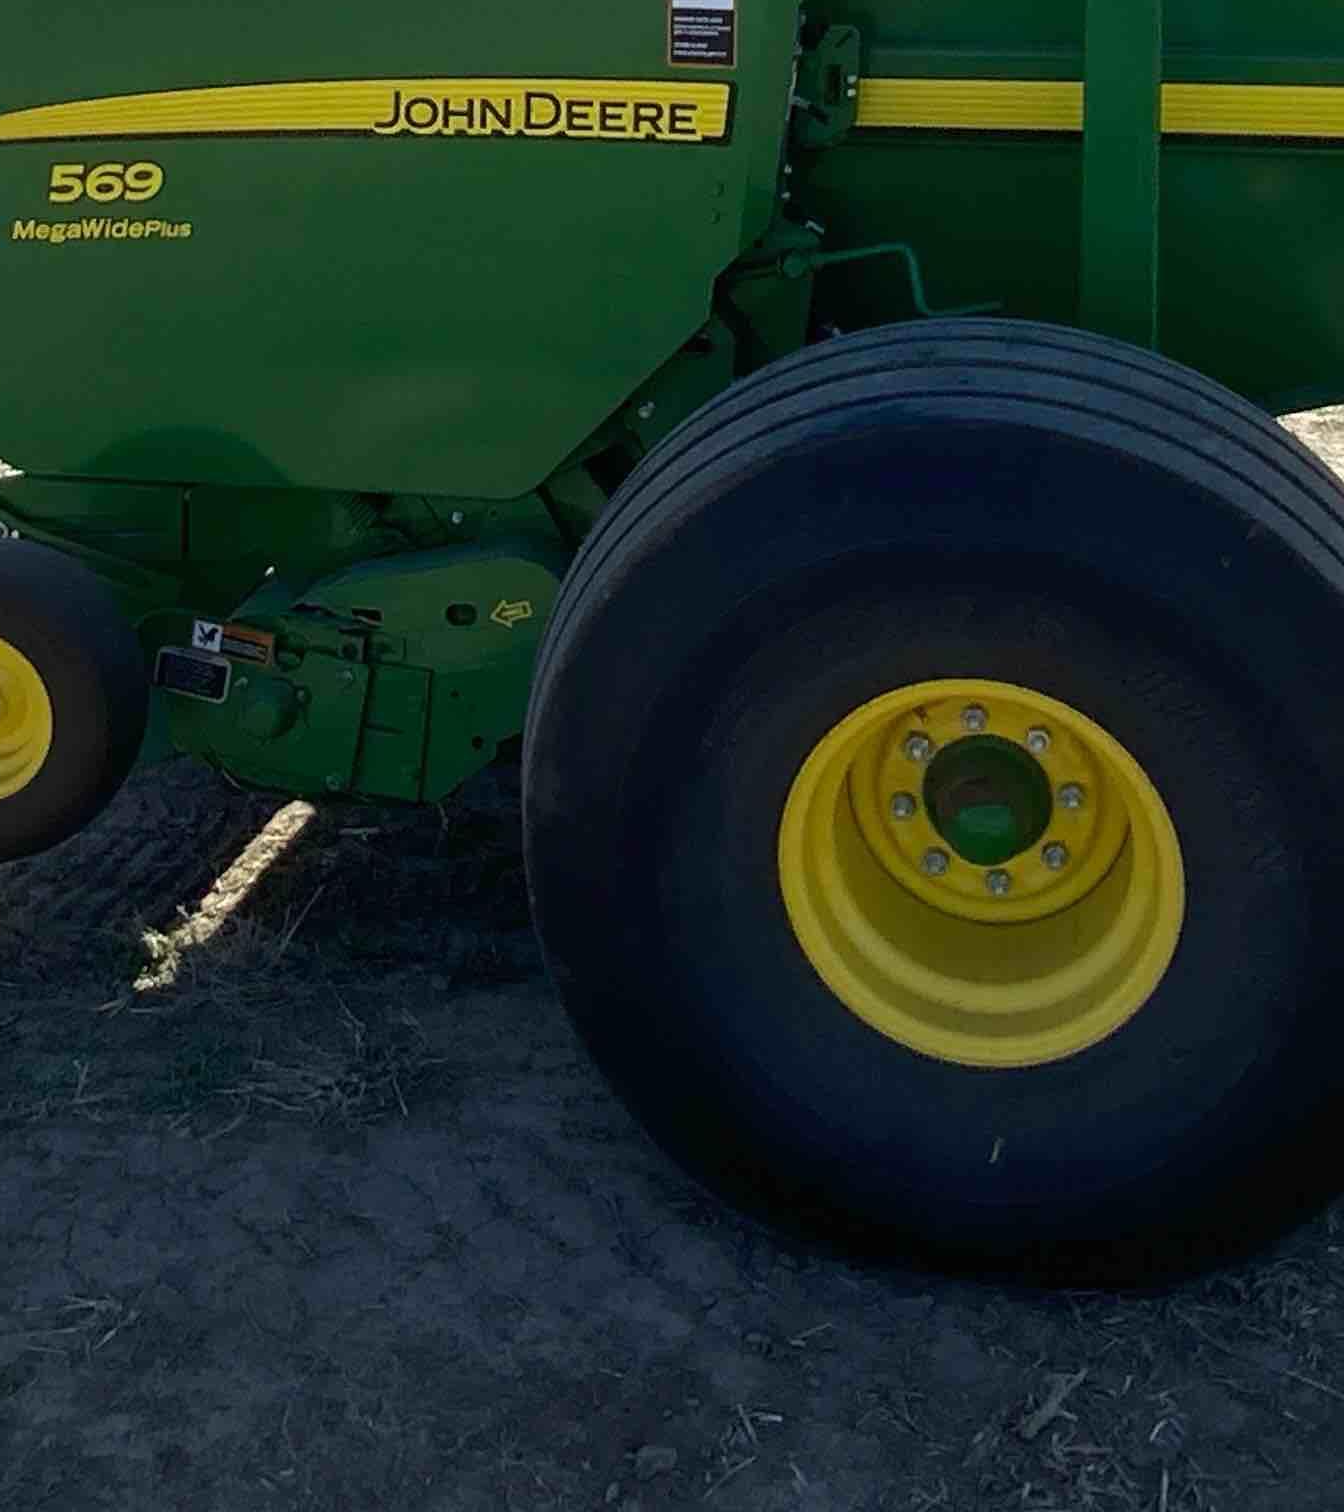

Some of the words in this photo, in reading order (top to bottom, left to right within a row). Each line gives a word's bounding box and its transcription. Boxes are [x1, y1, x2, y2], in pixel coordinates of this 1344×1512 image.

[373, 89, 513, 130] JOHN
[522, 90, 698, 135] DEERE
[48, 161, 164, 203] 569
[11, 217, 194, 244] MegaWidePlus
